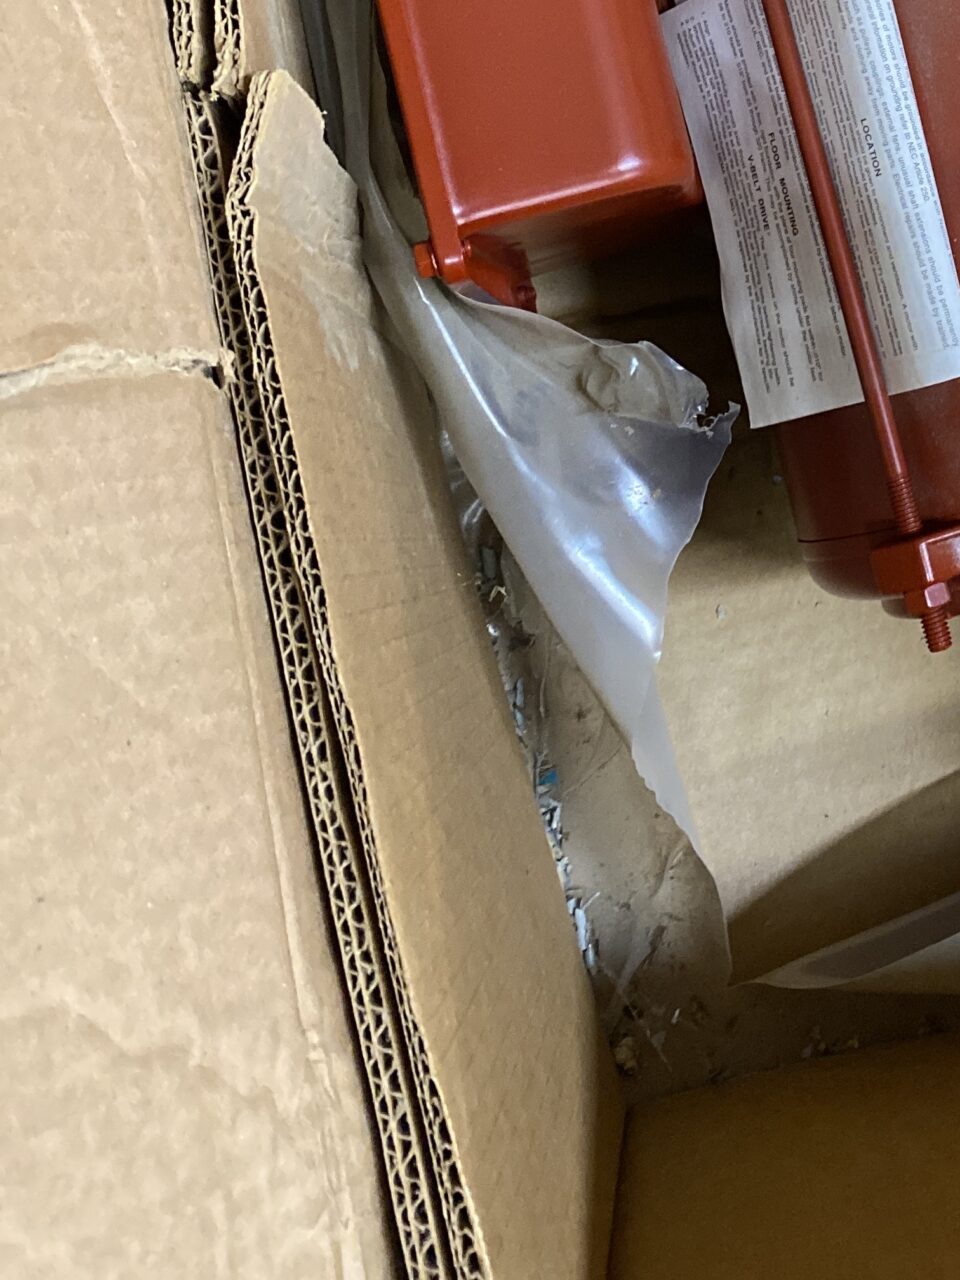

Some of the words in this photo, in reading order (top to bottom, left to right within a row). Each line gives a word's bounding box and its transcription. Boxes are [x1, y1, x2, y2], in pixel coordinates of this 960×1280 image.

[882, 23, 889, 32] of
[871, 20, 888, 62] information
[885, 33, 897, 60] motors
[883, 63, 891, 73] on
[893, 63, 905, 88] should
[885, 75, 903, 112] grounding
[901, 90, 909, 101] be
[898, 113, 909, 129] refer
[904, 103, 920, 140] grounded
[859, 118, 882, 177] LOCATION
[904, 132, 912, 140] to
[906, 141, 918, 159] NEC
[766, 131, 783, 169] FLOOR
[777, 177, 800, 236] MOUNTING
[913, 161, 925, 185] Article
[745, 154, 762, 193] V-BELT
[755, 197, 771, 231] DRIVE
